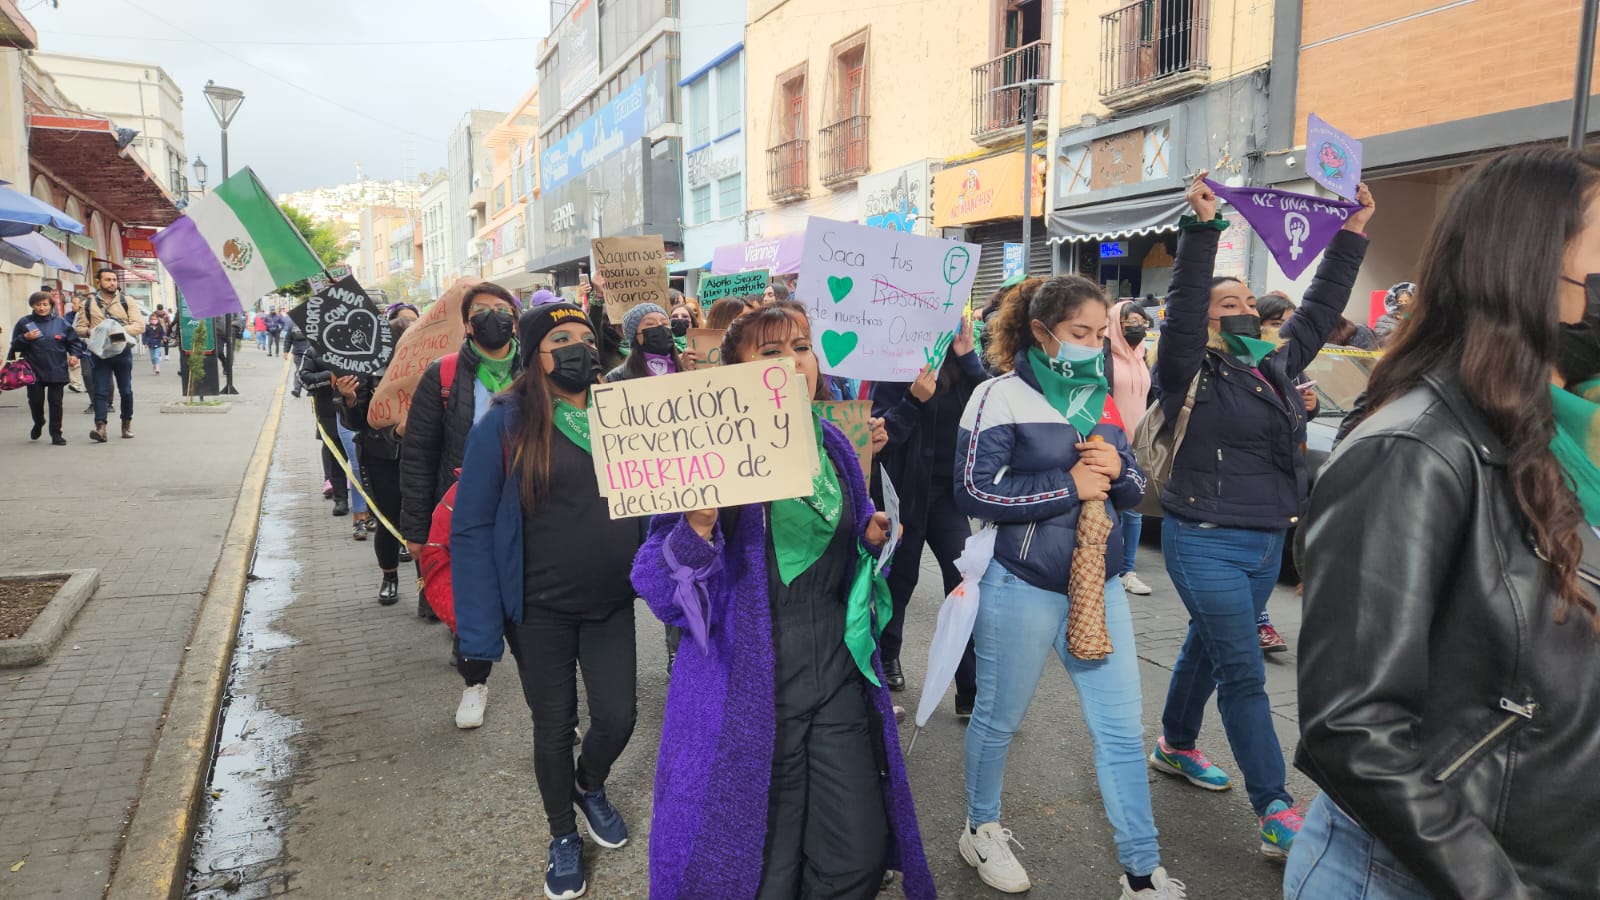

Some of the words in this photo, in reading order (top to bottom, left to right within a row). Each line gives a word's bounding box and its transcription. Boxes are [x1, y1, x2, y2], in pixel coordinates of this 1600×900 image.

[1280, 196, 1311, 213] UNA
[595, 241, 641, 267] Saquen
[643, 249, 662, 262] sus
[745, 244, 780, 263] Vianney
[819, 231, 865, 267] Saca
[890, 241, 913, 272] tus
[645, 265, 656, 276] de
[327, 286, 365, 308] AMOR
[725, 287, 730, 296] y
[305, 296, 324, 342] ABORTO
[324, 303, 348, 323] CON
[810, 298, 828, 321] de
[834, 309, 884, 327] nuestros
[322, 352, 373, 374] SEGURAS
[369, 398, 391, 423] NOS
[594, 380, 750, 429] Educación,
[601, 416, 756, 462] prevención
[770, 413, 790, 448] y
[606, 451, 725, 490] LIBERTAD
[737, 444, 772, 479] de
[613, 481, 722, 517] decisión
